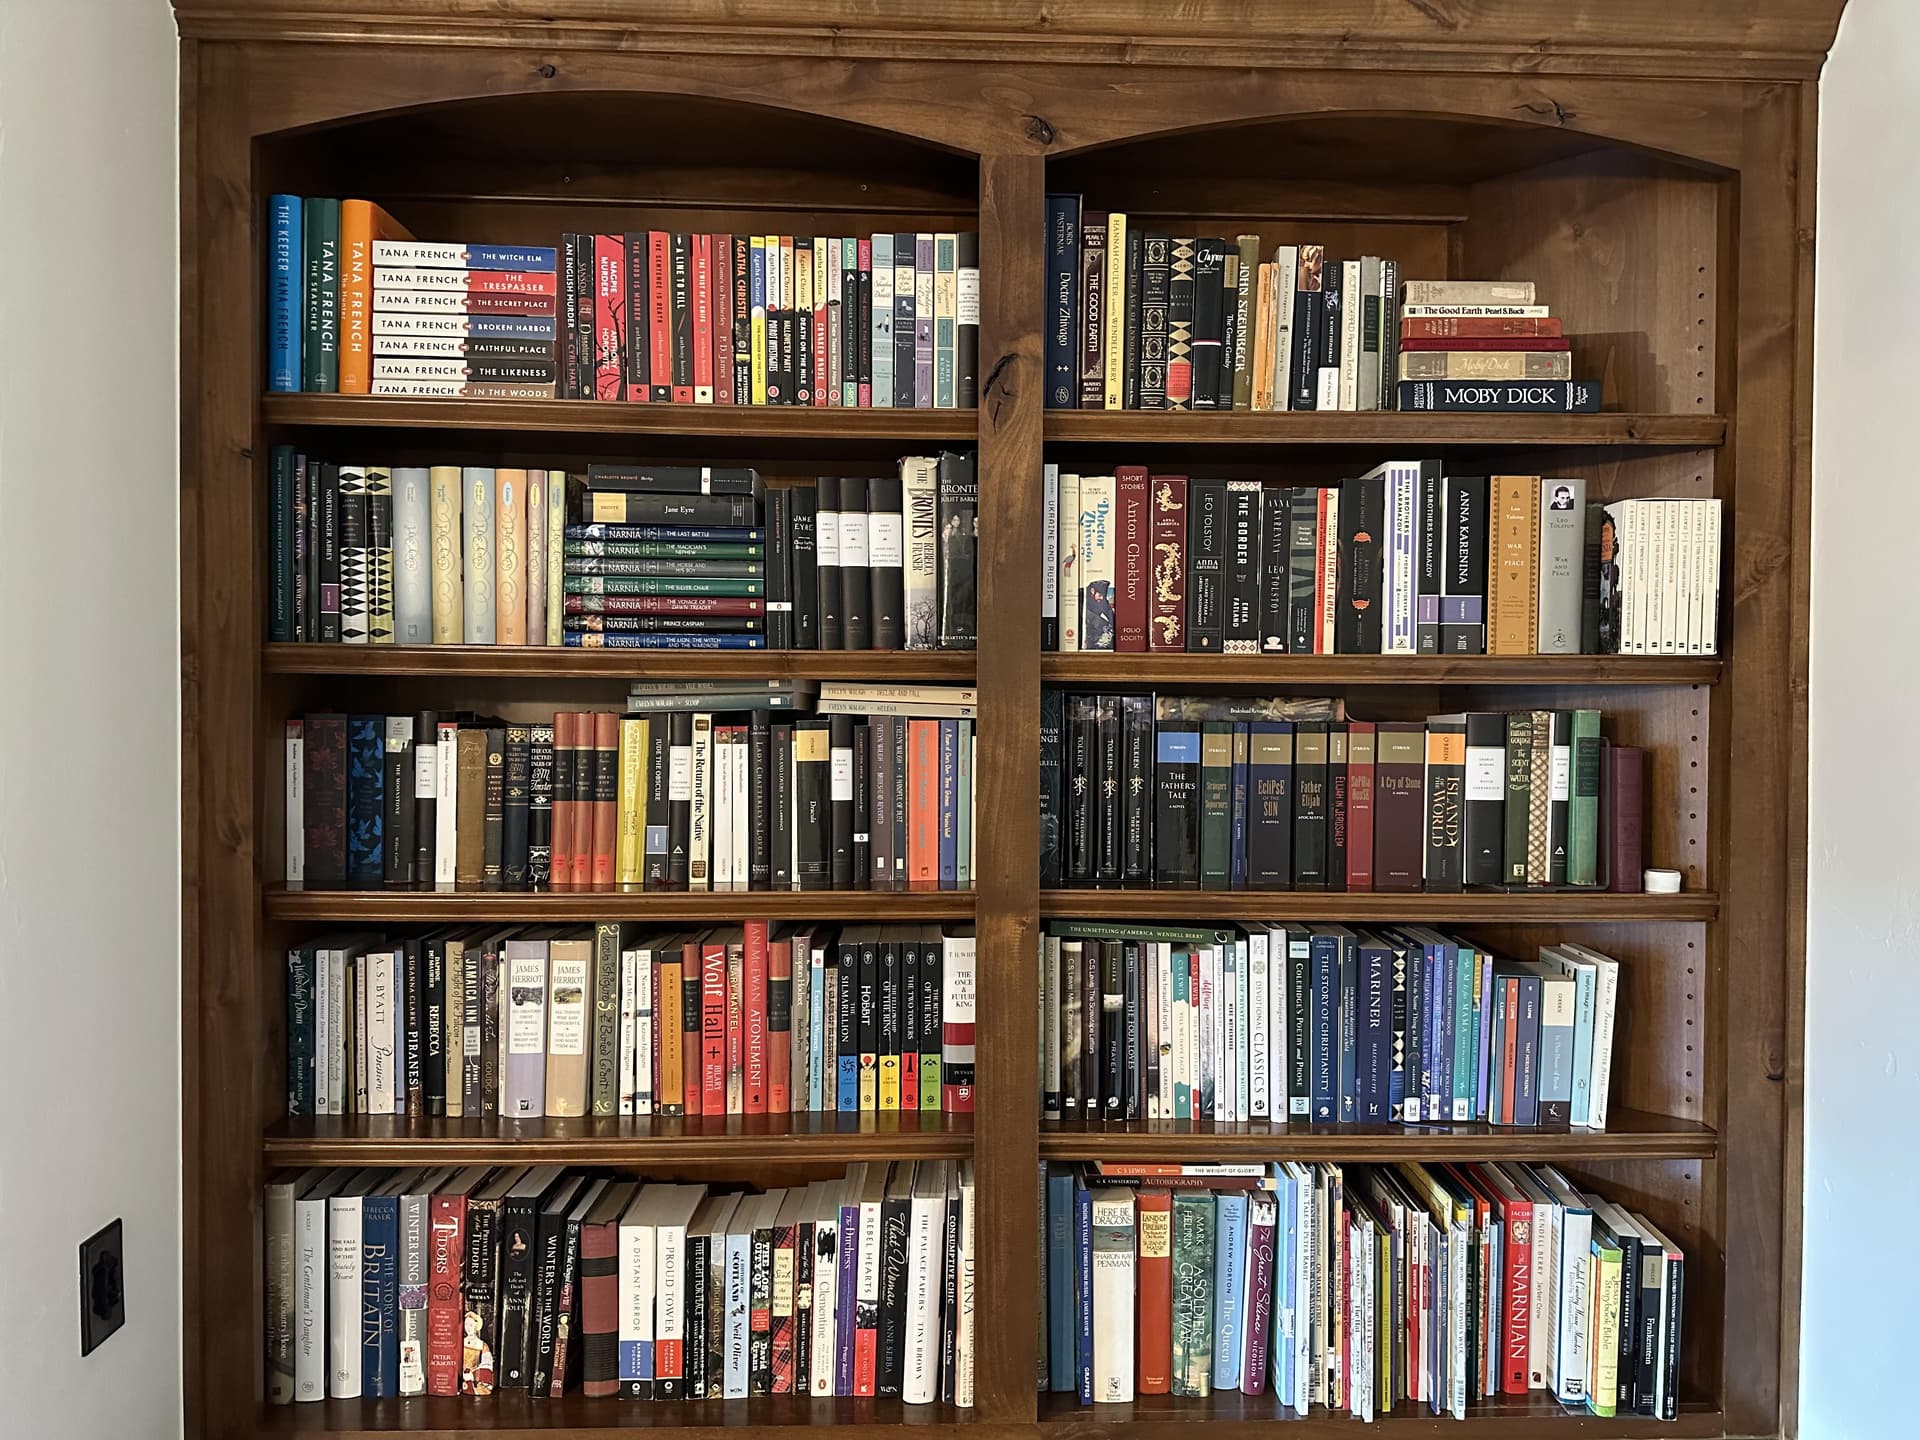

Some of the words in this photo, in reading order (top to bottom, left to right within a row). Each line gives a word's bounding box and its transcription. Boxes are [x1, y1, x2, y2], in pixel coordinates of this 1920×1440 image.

[278, 205, 289, 225] THE
[278, 230, 289, 270] KEEPER
[322, 241, 333, 282] TANA
[352, 241, 364, 283] TANA
[380, 249, 408, 257] TANA
[414, 250, 456, 259] FRENCH
[528, 254, 542, 262] ELM
[565, 243, 573, 252] AN
[737, 239, 746, 276] AGATHA
[279, 275, 289, 301] TANA
[382, 274, 411, 283] TANA
[417, 276, 458, 284] FRENCH
[483, 283, 544, 292] TRESPASSER
[1059, 272, 1071, 305] Doctor
[1089, 272, 1099, 291] THE
[1240, 262, 1249, 295] JOHN
[381, 296, 410, 304] TANA
[415, 297, 457, 306] FRENCH
[524, 300, 548, 308] PLACE
[567, 294, 575, 328] MURDER
[737, 280, 747, 319] CHRISTIE
[1089, 294, 1098, 321] GOOD
[1424, 307, 1438, 315] The
[1439, 307, 1460, 315] Good
[1462, 307, 1483, 315] Earth
[279, 304, 289, 349] FRENCH
[322, 291, 333, 352] FRENCH
[352, 292, 363, 352] FRENCH
[381, 320, 410, 328] TANA
[416, 321, 457, 330] FRENCH
[478, 324, 514, 332] BROKEN
[516, 324, 550, 332] HARBOR
[1059, 307, 1071, 346] Zhivago
[380, 341, 408, 350] TANA
[414, 342, 455, 351] FRENCH
[474, 345, 517, 353] FAITHFUL
[520, 346, 547, 354] PLACE
[610, 329, 618, 369] ANTHONY
[1089, 324, 1098, 352] EARTH
[381, 366, 409, 374] TANA
[415, 366, 457, 375] FRENCH
[479, 368, 497, 376] THE
[501, 368, 547, 377] LIKENESS
[413, 386, 455, 394] FRENCH
[509, 389, 548, 398] WOODS
[1444, 388, 1502, 404] MOBY
[1507, 387, 1557, 404] DICK
[1205, 493, 1213, 511] LEO
[1238, 495, 1248, 516] THE
[1460, 490, 1469, 523] ANNA
[608, 530, 641, 539] NARNIA
[1127, 499, 1140, 540] Anton
[1204, 513, 1213, 551] TOLSTOY
[1237, 522, 1248, 565] BORDER
[1458, 525, 1469, 584] KARENINA
[1127, 542, 1140, 600] Chekhov
[607, 584, 640, 592] NARNIA
[1232, 597, 1240, 627] FATLAND
[697, 739, 705, 757] The
[1161, 782, 1196, 790] FATHER'S
[1169, 791, 1187, 799] TALE
[694, 814, 704, 841] Native
[809, 801, 817, 824] Dracula
[1432, 789, 1444, 847] WORLD
[1447, 776, 1460, 847] ISLAND
[408, 955, 416, 992] SUSANNA
[511, 975, 543, 983] HERRIOT
[515, 964, 540, 973] JAMES
[704, 952, 723, 996] Wolf
[729, 953, 737, 990] HILARY
[1320, 954, 1329, 973] THE
[465, 959, 477, 1001] JAMAICA
[1320, 975, 1329, 1007] STORY
[1370, 956, 1382, 1028] MARINER
[408, 995, 416, 1026] CLARKE
[465, 1006, 477, 1022] INN
[730, 992, 738, 1032] MANTEL
[861, 985, 871, 1025] HOBBIT
[1320, 1008, 1329, 1021] OF
[429, 1005, 440, 1057] REBECCA
[704, 1004, 722, 1040] Hall
[408, 1031, 419, 1091] PIRANESI
[750, 1010, 761, 1088] ATONEMENT
[1253, 1032, 1265, 1094] CLASSICS
[1320, 1022, 1328, 1092] CHRISTIANITY
[1144, 1178, 1204, 1186] AUTOBIOGRAPHY
[408, 1203, 420, 1246] WINTER
[1094, 1216, 1132, 1224] DRAGONS
[1098, 1208, 1117, 1216] HERE
[1118, 1208, 1128, 1216] BE
[433, 1216, 459, 1274] TUDORS
[865, 1217, 874, 1247] REBEL
[384, 1255, 393, 1276] THE
[408, 1248, 419, 1281] KING
[665, 1248, 675, 1287] PROUD
[865, 1252, 873, 1293] HEARTS
[364, 1243, 386, 1348] BRITAIN
[384, 1281, 392, 1315] STORY
[665, 1290, 674, 1333] TOWER
[1511, 1263, 1528, 1359] NARNIAN
[384, 1319, 392, 1333] OF
[1645, 1317, 1655, 1365] Frankenstein
